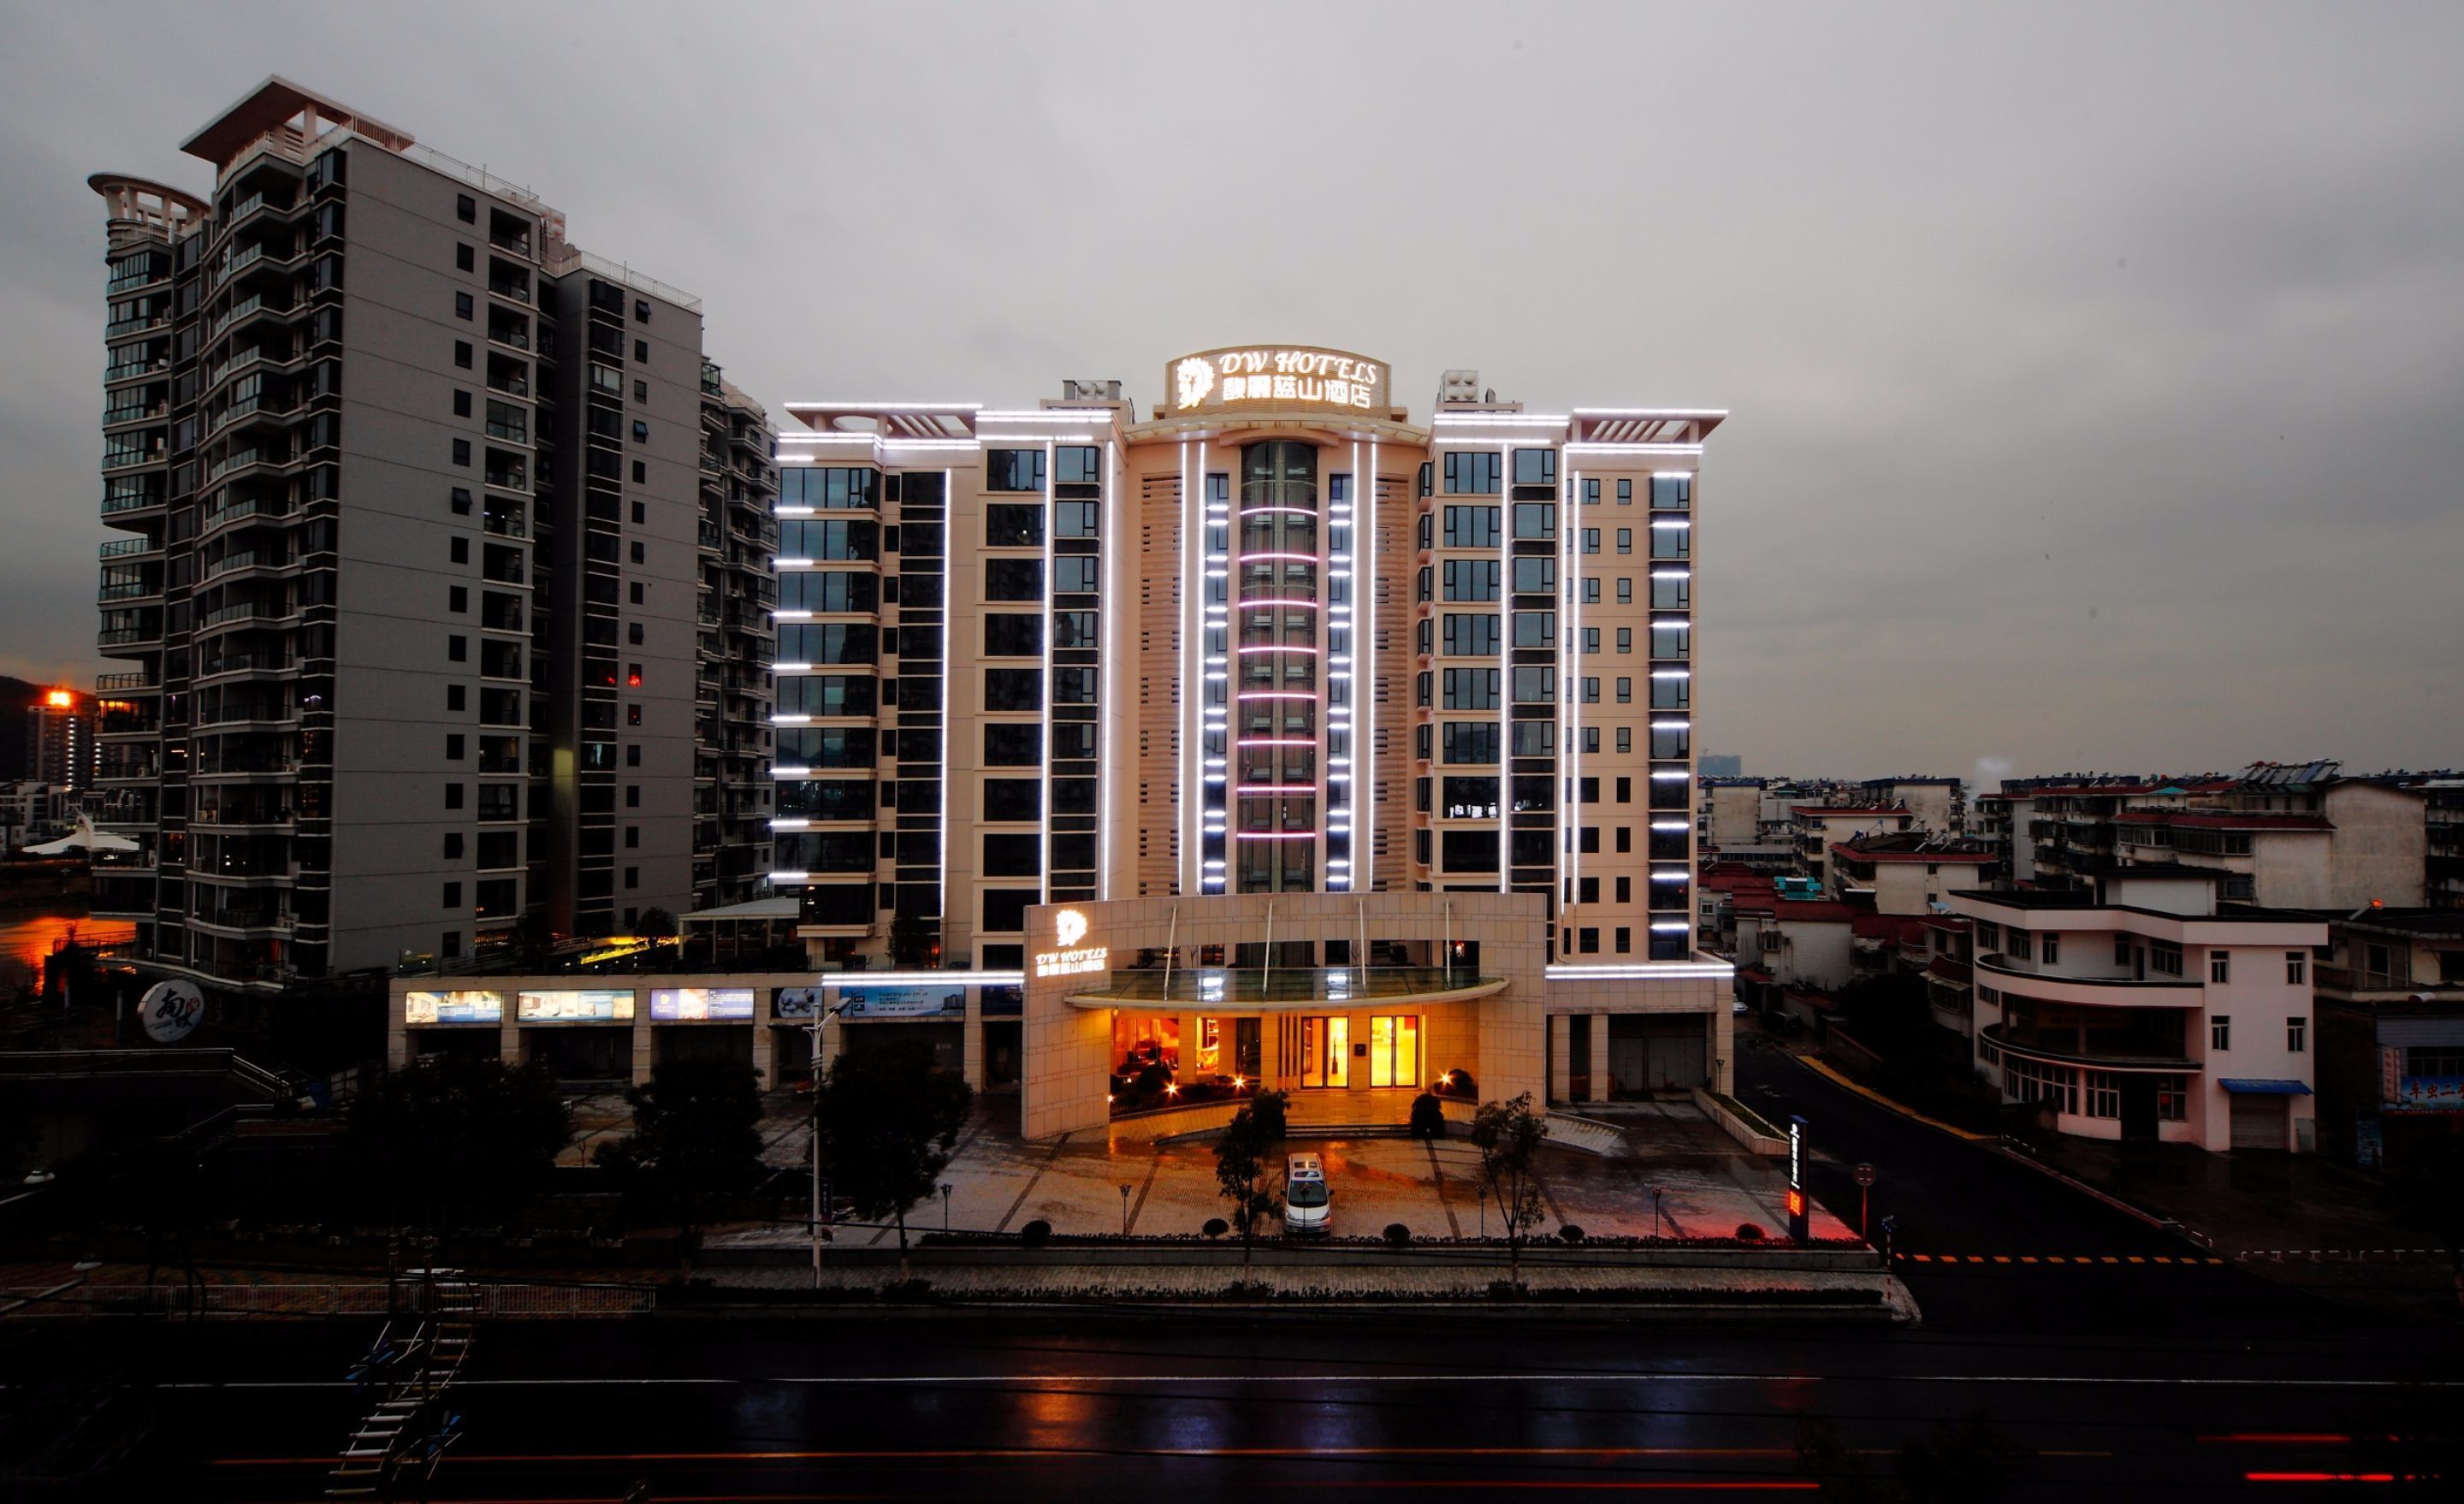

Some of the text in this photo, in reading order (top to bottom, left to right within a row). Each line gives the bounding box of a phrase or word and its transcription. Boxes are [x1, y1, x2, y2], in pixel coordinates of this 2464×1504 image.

[1219, 351, 1377, 385] DW HOTELS
[1035, 947, 1108, 966] DW HOTELS
